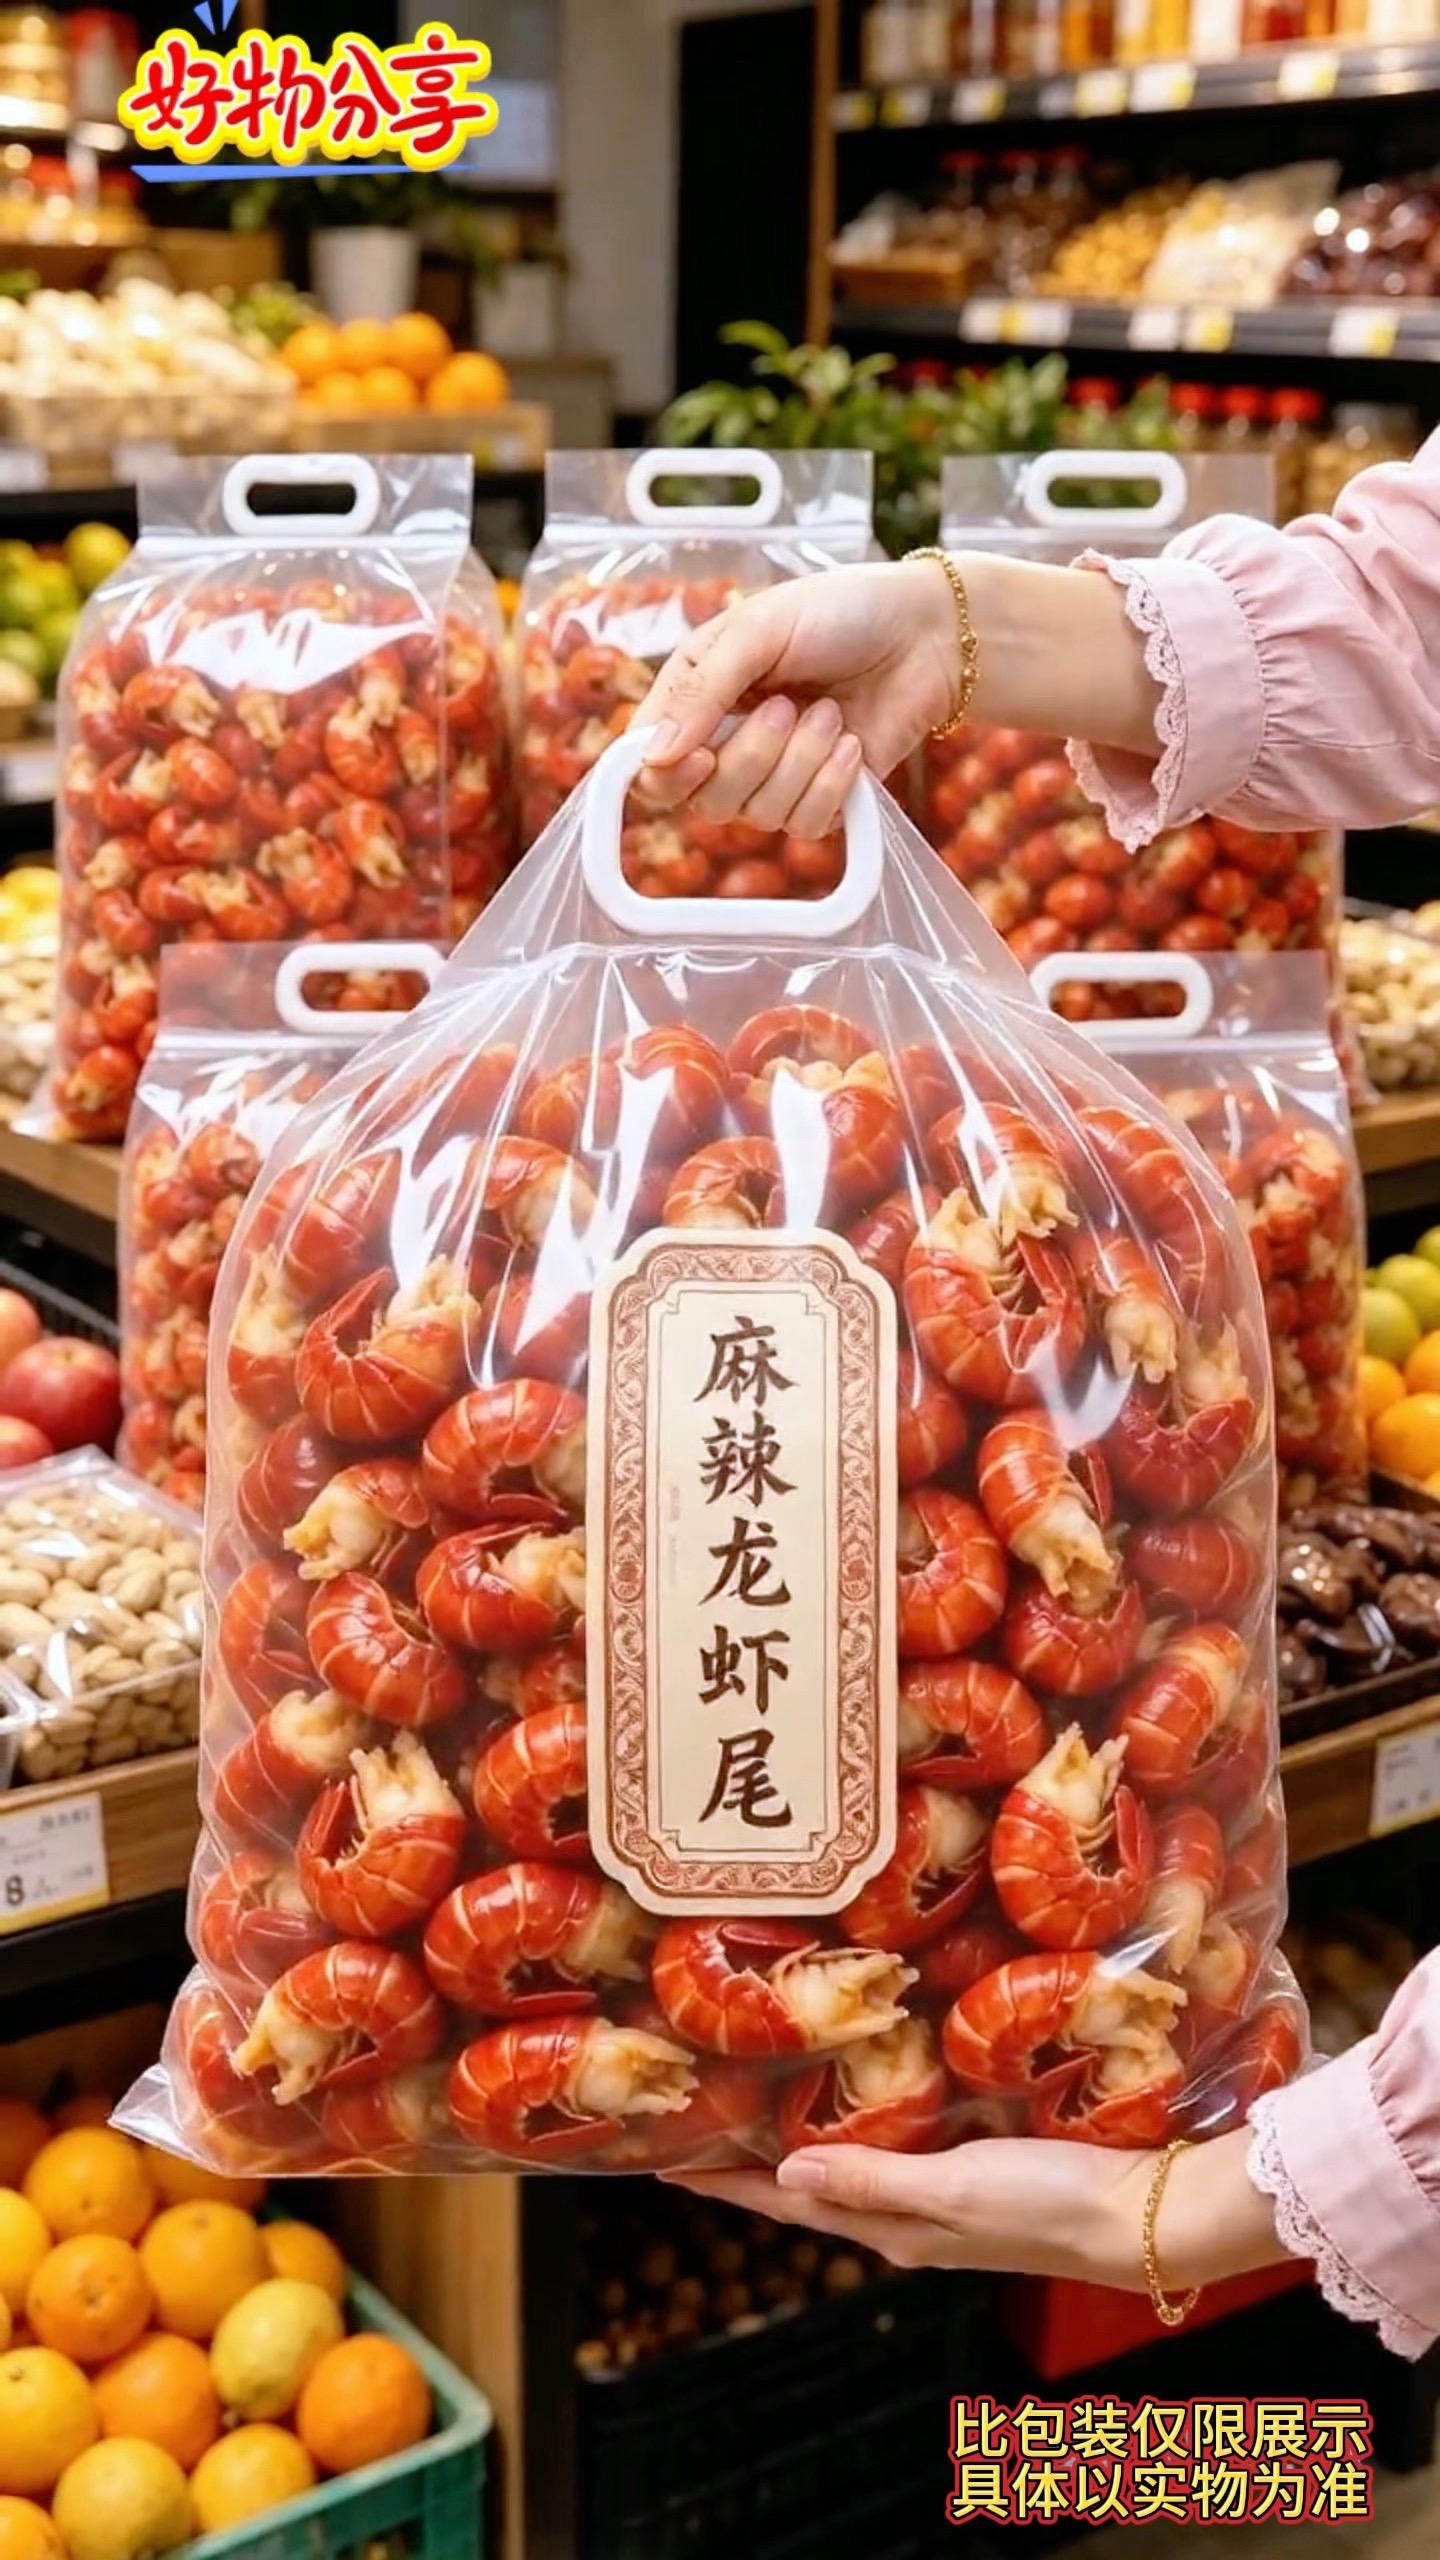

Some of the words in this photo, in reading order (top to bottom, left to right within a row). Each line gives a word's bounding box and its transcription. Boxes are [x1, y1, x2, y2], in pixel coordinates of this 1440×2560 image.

[694, 1316, 798, 1829] 麻辣龙虾尾
